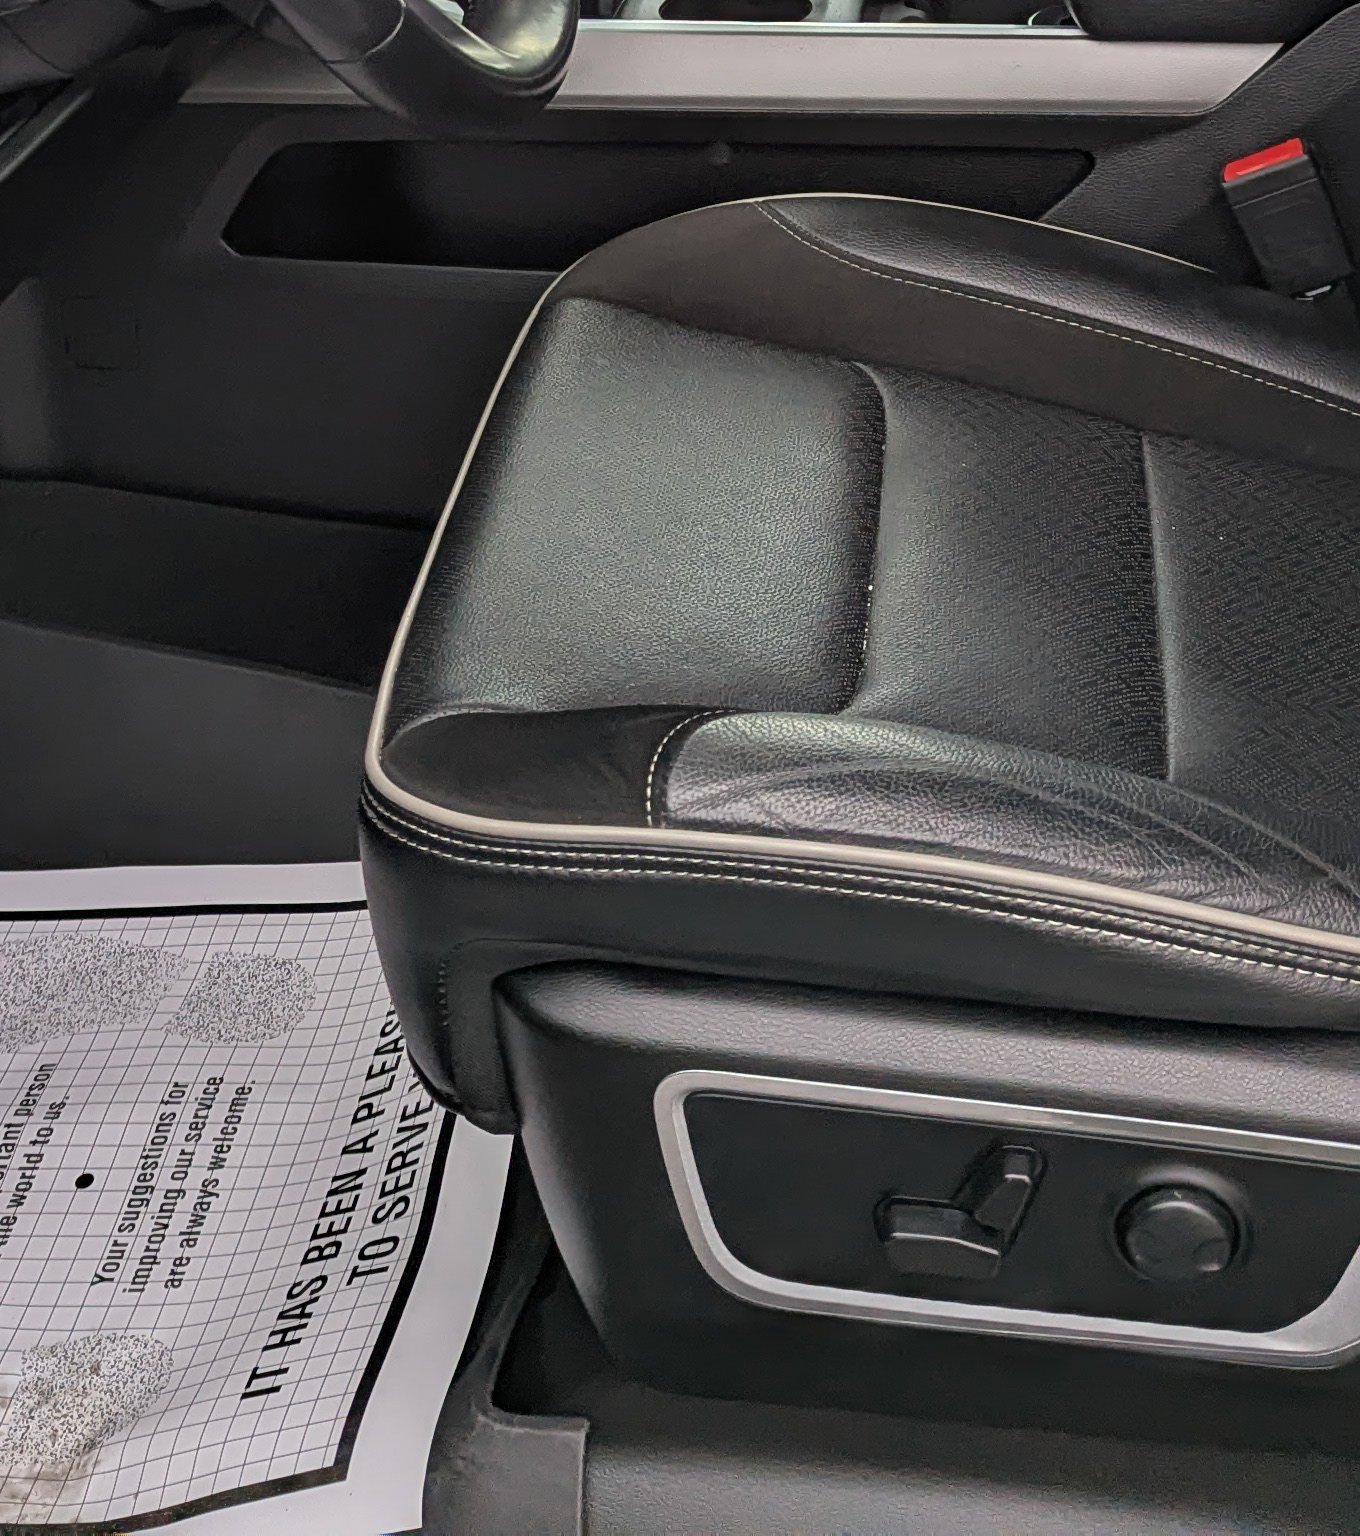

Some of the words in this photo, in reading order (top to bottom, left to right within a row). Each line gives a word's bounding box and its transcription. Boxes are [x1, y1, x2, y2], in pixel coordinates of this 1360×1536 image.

[14, 1063, 56, 1116] person
[351, 1010, 405, 1125] PLEAS
[7, 1153, 44, 1208] world
[29, 1127, 53, 1146] to
[44, 1095, 70, 1120] us.
[90, 1240, 128, 1286] Your
[118, 1112, 176, 1233] suggestions
[161, 1082, 189, 1105] for
[122, 1189, 186, 1293] improving
[171, 1149, 194, 1181] our
[185, 1076, 224, 1142] service
[164, 1256, 191, 1289] are
[179, 1178, 219, 1248] always
[207, 1080, 255, 1171] welcome.
[343, 1129, 379, 1155] A
[372, 1099, 435, 1224] SERVE
[301, 1167, 367, 1265] BEEN
[346, 1235, 400, 1287] TO
[262, 1275, 328, 1351] HAS
[241, 1367, 289, 1401] IT
